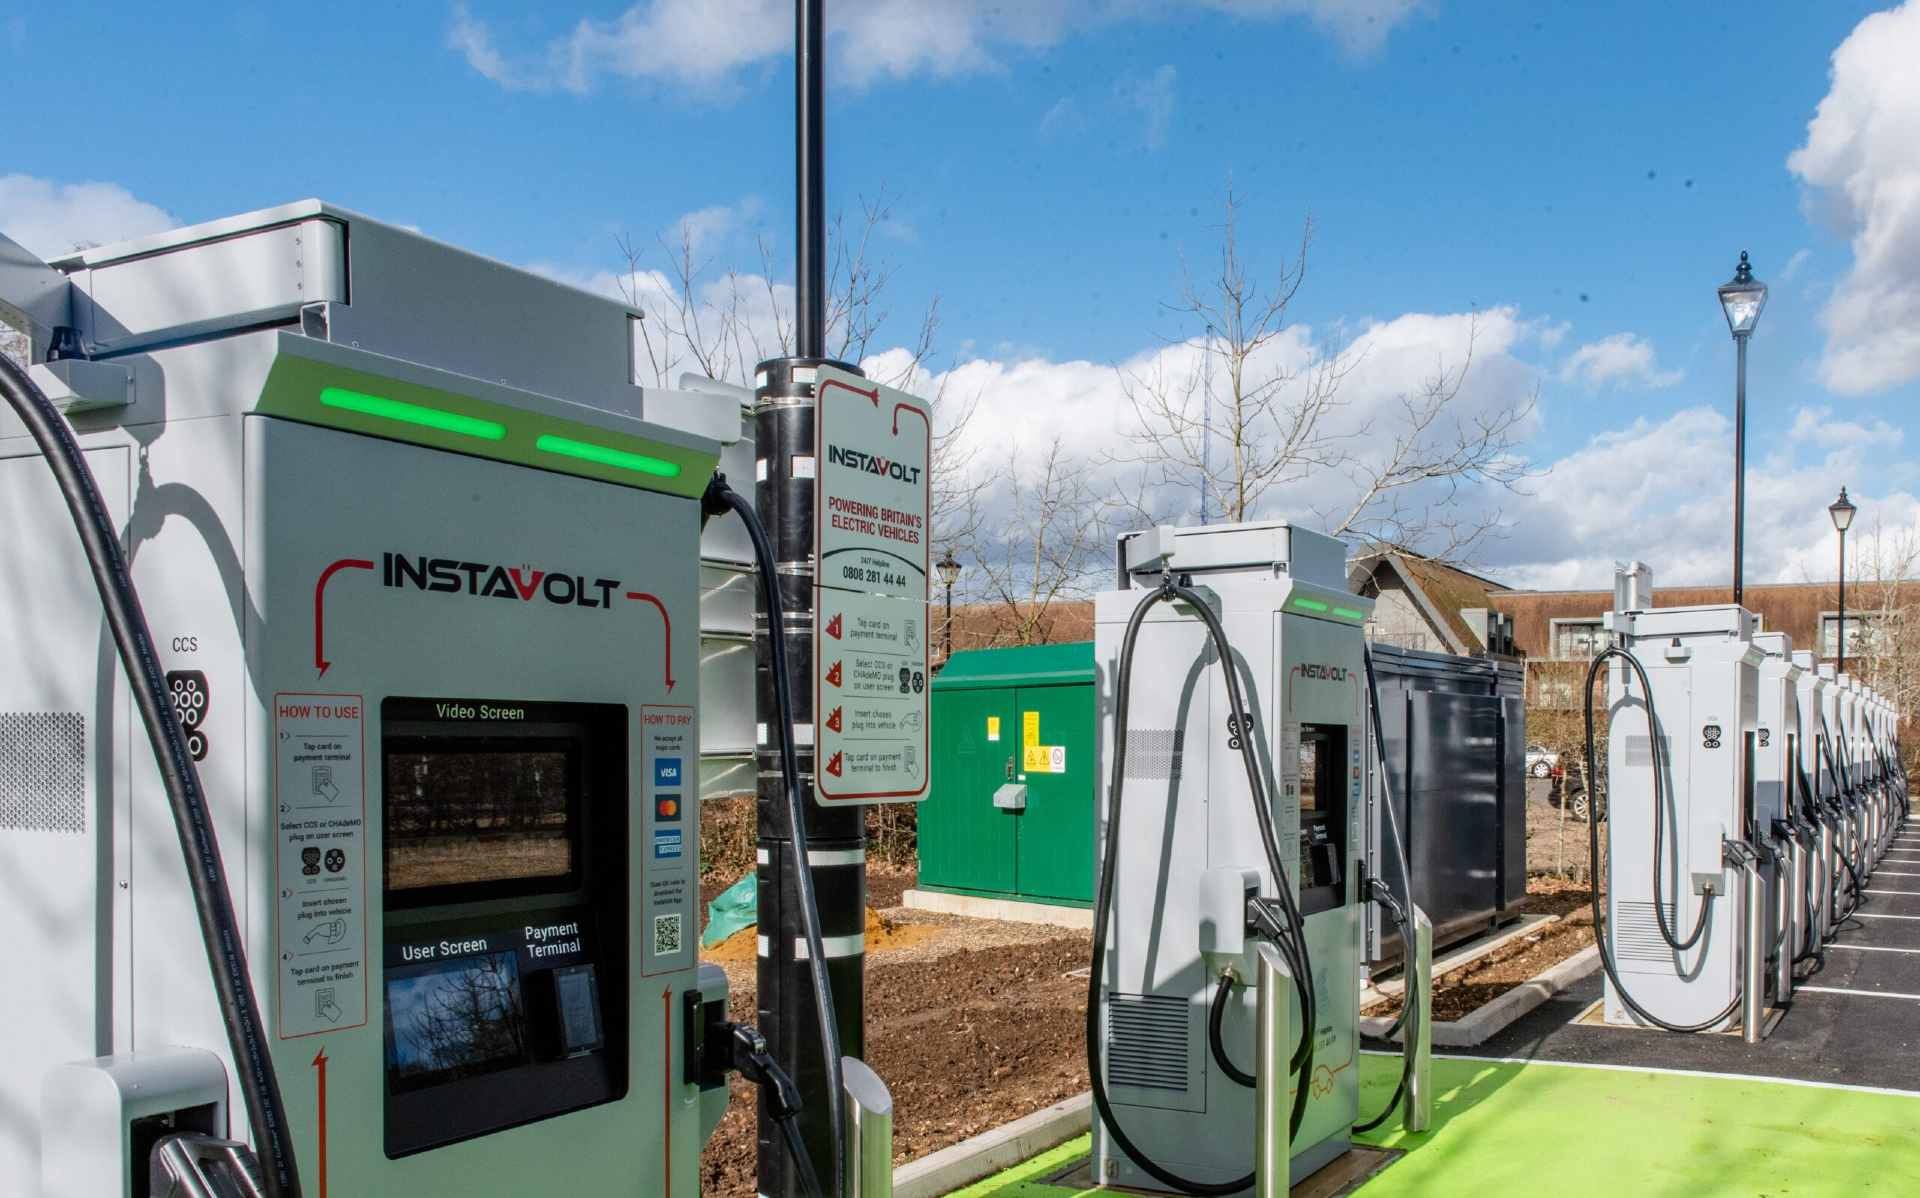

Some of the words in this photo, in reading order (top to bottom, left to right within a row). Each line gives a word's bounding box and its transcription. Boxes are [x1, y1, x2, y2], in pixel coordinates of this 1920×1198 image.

[828, 444, 921, 485] INSTAVOLT
[828, 496, 879, 520] POWERING
[880, 508, 922, 529] BRITAIN'S
[831, 514, 876, 536] ELECTRIC
[878, 523, 920, 544] VEHICLES
[383, 552, 621, 609] INSTAVOLT
[843, 565, 864, 582] 0808
[866, 569, 881, 584] 281
[883, 572, 895, 585] 44
[896, 575, 906, 587] 44
[834, 624, 839, 635] 1
[868, 620, 881, 630] card
[883, 622, 891, 630] on
[850, 629, 875, 641] payment
[876, 631, 898, 641] terminal
[172, 636, 198, 652] CCS
[834, 672, 840, 682] 2
[1301, 663, 1348, 681] INSTAVOLT
[882, 673, 895, 684] plug
[280, 705, 310, 718] HOW
[314, 705, 331, 718] TO
[334, 706, 359, 719] USE
[435, 703, 476, 719] Video
[479, 704, 525, 720] Screen
[644, 713, 663, 725] HOW
[673, 714, 692, 725] PAY
[834, 718, 840, 729] 3
[852, 721, 864, 731] plug
[303, 742, 316, 751] Tap
[317, 742, 333, 750] card
[293, 753, 323, 763] payment
[324, 753, 352, 761] terminal
[878, 754, 902, 764] payment
[660, 768, 677, 777] VISA
[834, 762, 840, 773] 4
[280, 822, 302, 830] Select
[319, 821, 327, 829] or
[289, 834, 304, 843] plug
[297, 912, 313, 921] plug
[525, 922, 580, 942] Payment
[402, 944, 436, 961] User
[439, 937, 488, 956] Screen
[526, 938, 582, 959] Terminal
[290, 968, 303, 976] Tap
[304, 965, 320, 974] card
[320, 964, 330, 972] on
[331, 961, 360, 972] payment
[334, 971, 355, 980] finish
